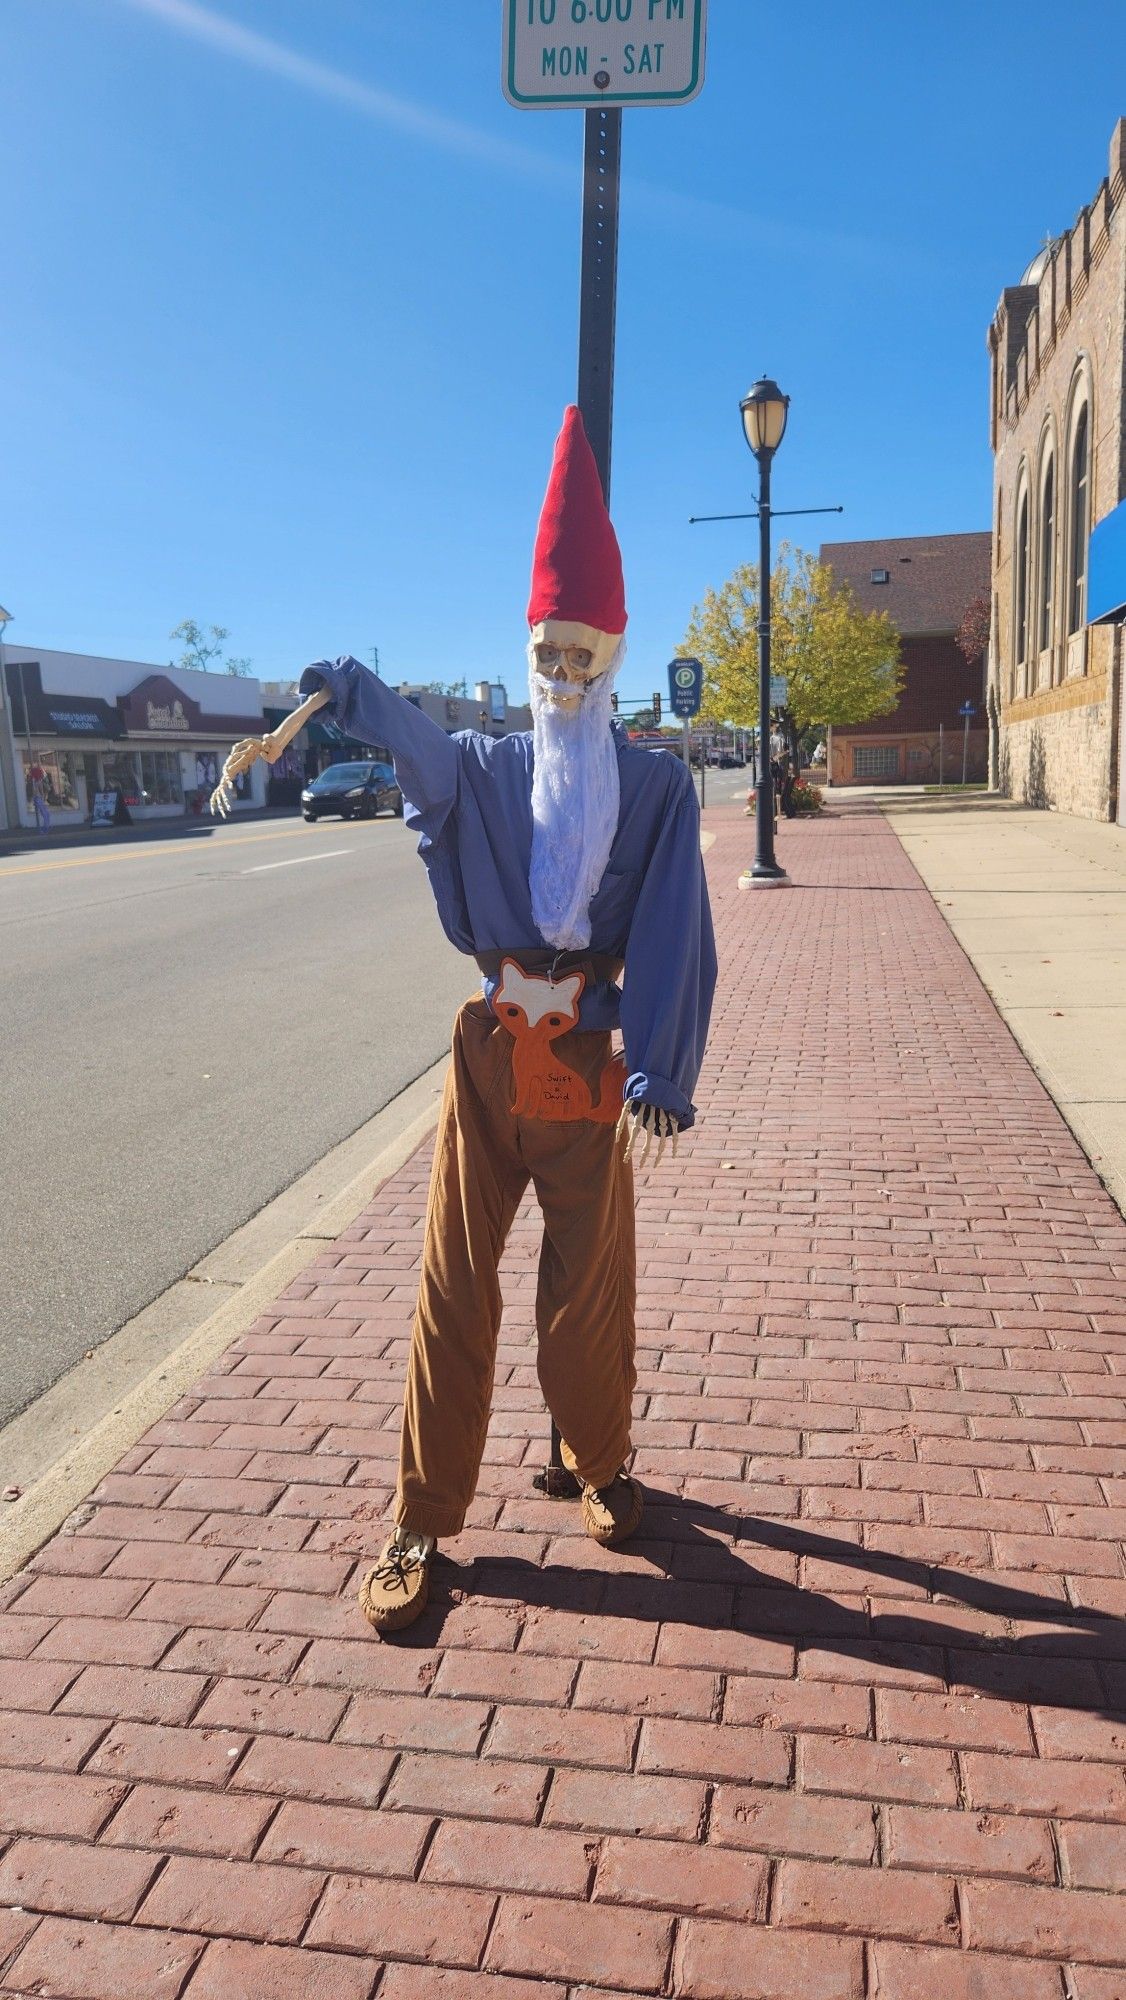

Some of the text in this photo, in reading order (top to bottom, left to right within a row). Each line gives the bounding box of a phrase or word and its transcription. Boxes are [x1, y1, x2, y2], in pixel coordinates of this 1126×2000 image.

[648, 0, 684, 20] PM
[542, 46, 588, 76] MON
[623, 44, 665, 74] SAT
[681, 672, 691, 684] P
[547, 1073, 572, 1082] Swift
[543, 1091, 570, 1101] David
